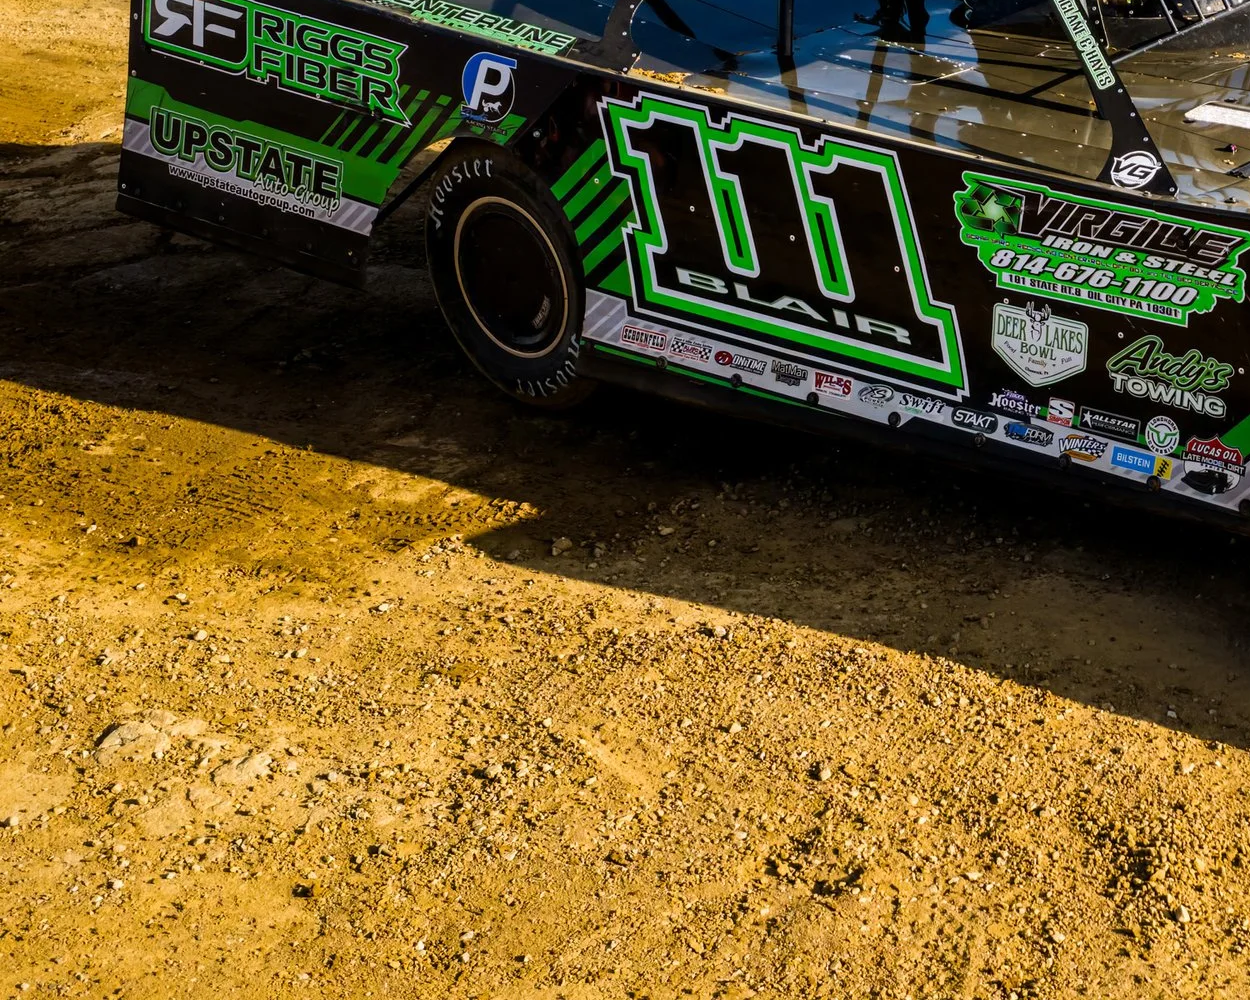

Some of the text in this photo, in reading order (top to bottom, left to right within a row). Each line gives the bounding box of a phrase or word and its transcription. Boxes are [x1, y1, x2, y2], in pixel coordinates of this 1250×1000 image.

[254, 10, 397, 77] RIGGS
[254, 44, 397, 112] FIBER
[1085, 46, 1113, 88] HAYES
[152, 107, 342, 200] UPSTATE
[168, 163, 317, 219] www.upstateautogroup.com
[253, 172, 341, 217] Auto Group
[612, 105, 955, 376] 111
[1042, 235, 1114, 259] IRON
[1114, 251, 1138, 265] &
[990, 248, 1199, 306] 814-676-1100
[675, 265, 912, 346] BLAIR
[1029, 278, 1059, 293] STATE
[1087, 289, 1104, 303] OIL
[1105, 292, 1128, 308] CITY
[1129, 298, 1145, 311] PA
[623, 328, 666, 348] SCHOENFELD
[996, 313, 1083, 354] DEER LAKES
[1020, 341, 1057, 361] BOWL
[1107, 337, 1234, 391] Andy's
[771, 360, 809, 380] MatMan
[815, 371, 852, 396] WILES
[988, 392, 1042, 415] Hoosier
[1109, 372, 1227, 417] TOWING
[953, 408, 996, 428] STAKT
[1091, 413, 1137, 430] ALLSTAR
[1091, 421, 1136, 436] PERFORMANCE
[1116, 452, 1151, 469] BILSTEIN
[1182, 452, 1245, 475] LATE MODEL DIRT
[1191, 442, 1238, 462] LUCAS OIL
